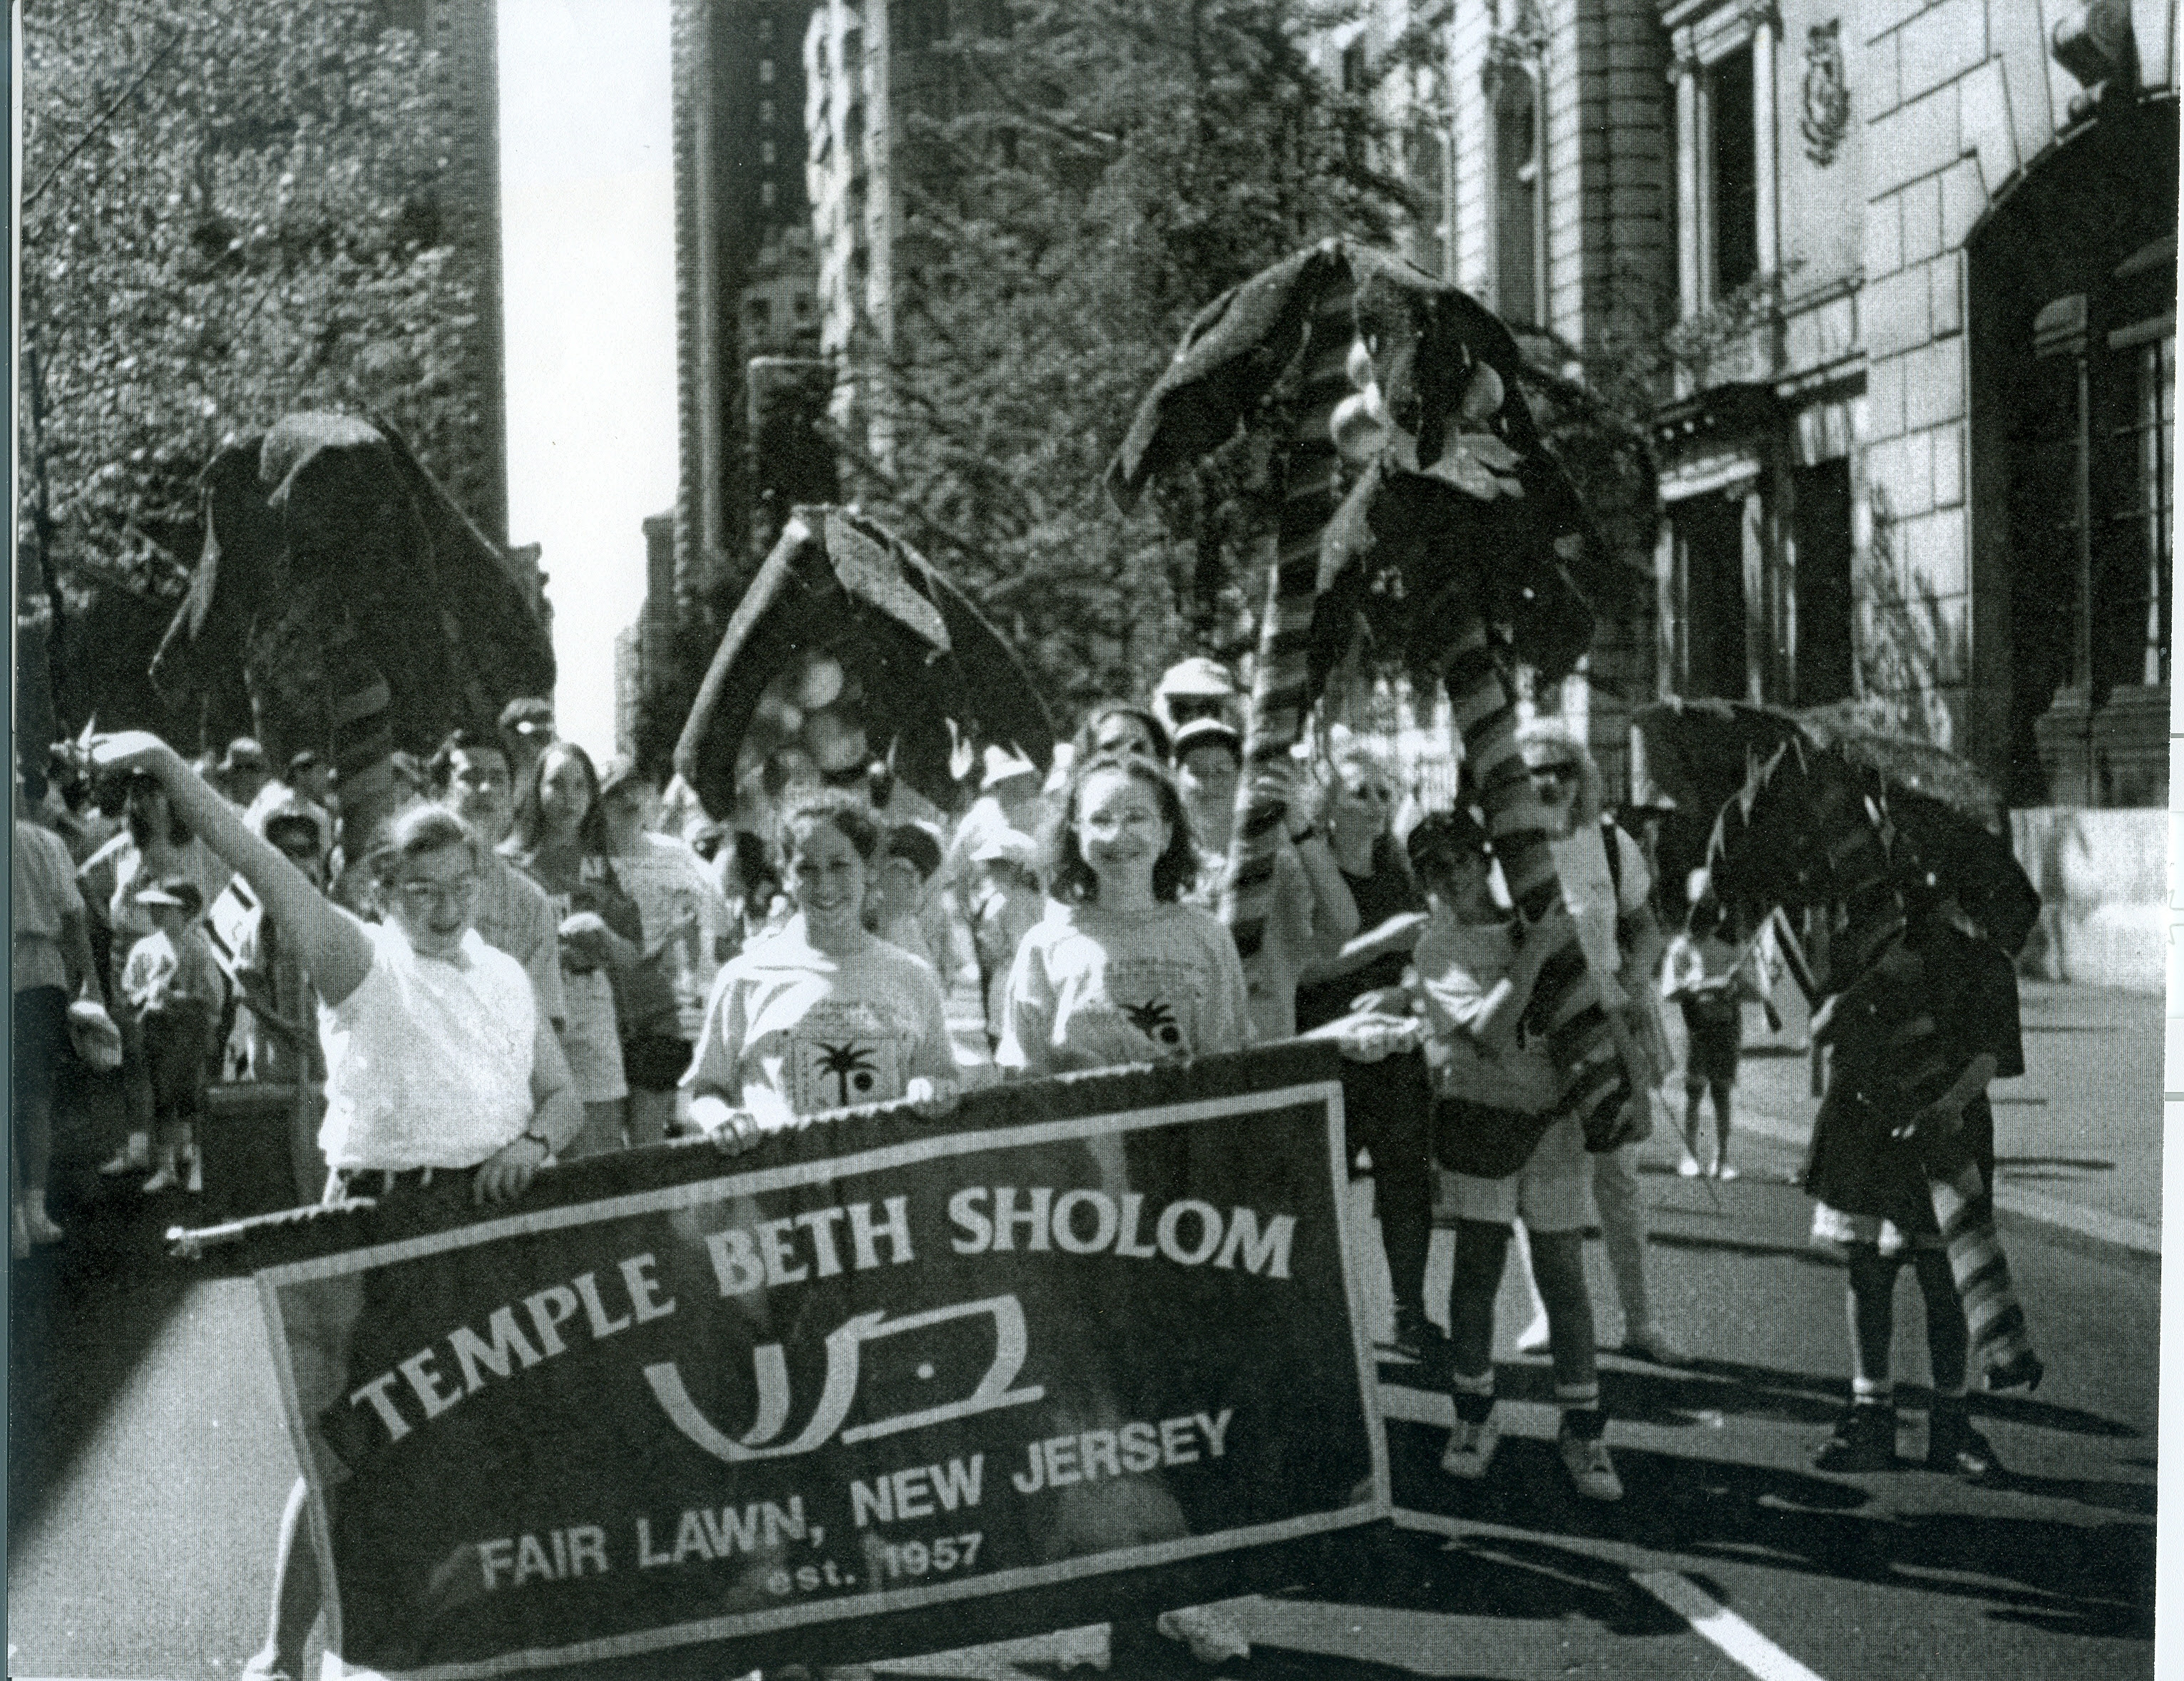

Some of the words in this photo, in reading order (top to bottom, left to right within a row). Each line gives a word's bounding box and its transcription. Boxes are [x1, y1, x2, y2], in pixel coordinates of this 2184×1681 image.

[351, 1254, 676, 1443] TEMPLE
[706, 1197, 913, 1297] BETH
[948, 1187, 1297, 1280] SHOLOM
[477, 1525, 610, 1590] FAIR
[637, 1495, 825, 1568] LAWN,
[849, 1456, 985, 1527] NEW
[1011, 1409, 1236, 1495] JERSEY
[765, 1562, 858, 1596] est.
[883, 1533, 983, 1579] 1957
